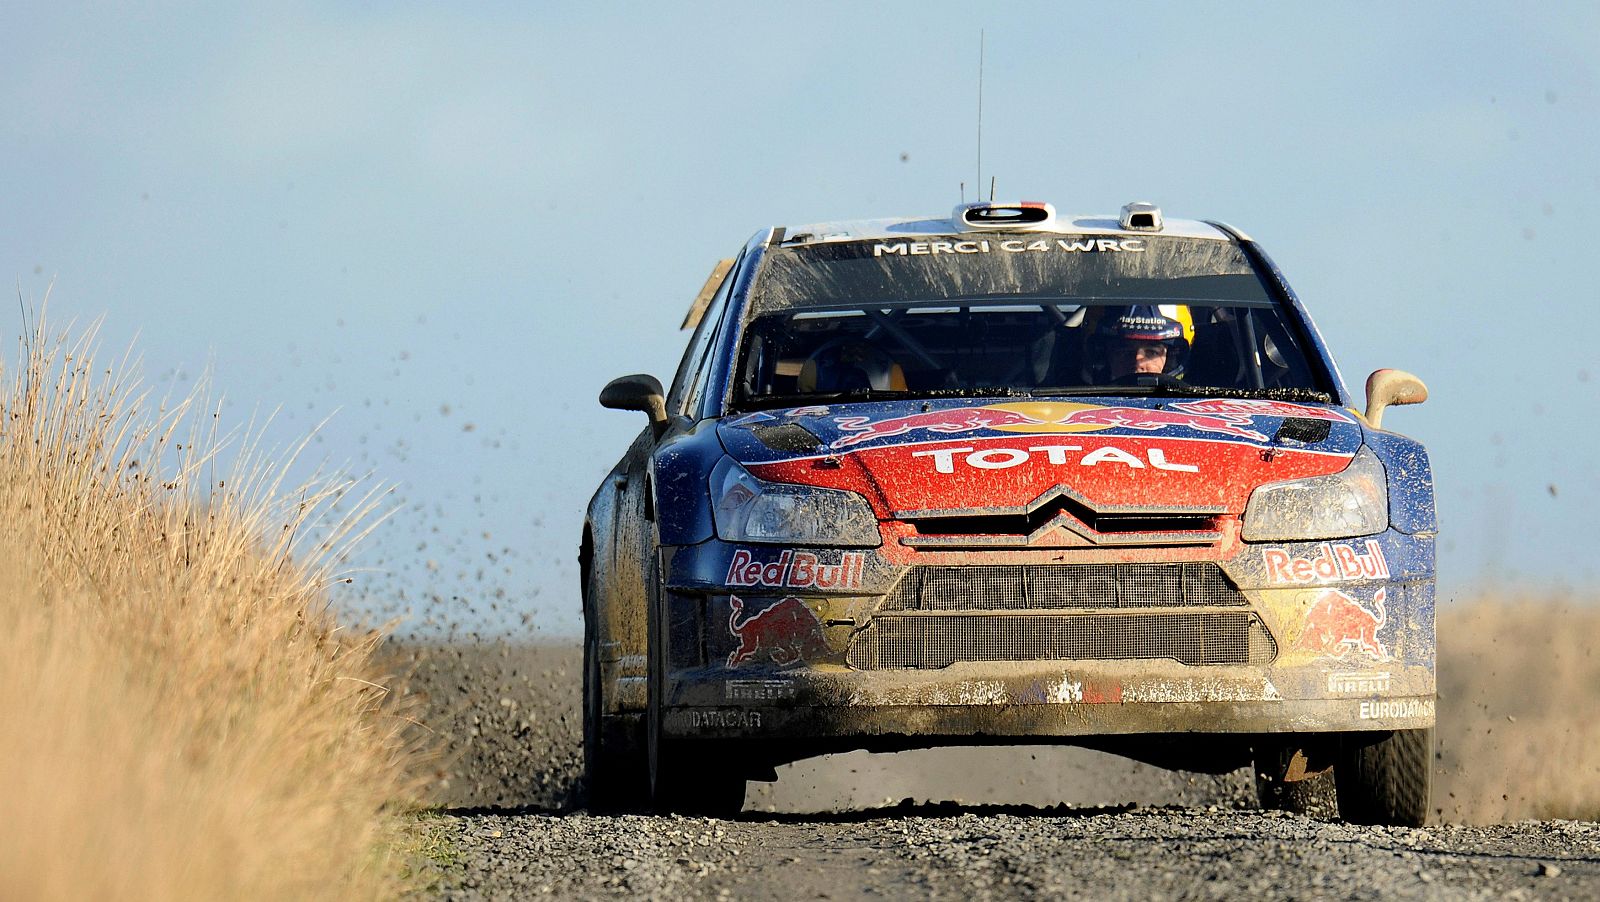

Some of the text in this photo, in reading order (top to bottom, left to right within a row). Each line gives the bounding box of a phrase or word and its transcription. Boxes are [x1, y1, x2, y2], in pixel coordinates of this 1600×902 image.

[873, 239, 1146, 257] MERCI C4 WRC
[912, 445, 1200, 474] TOTAL
[725, 549, 866, 591] Red Bull
[1262, 540, 1391, 583] Red Bull
[1328, 671, 1390, 692] PIRELLI
